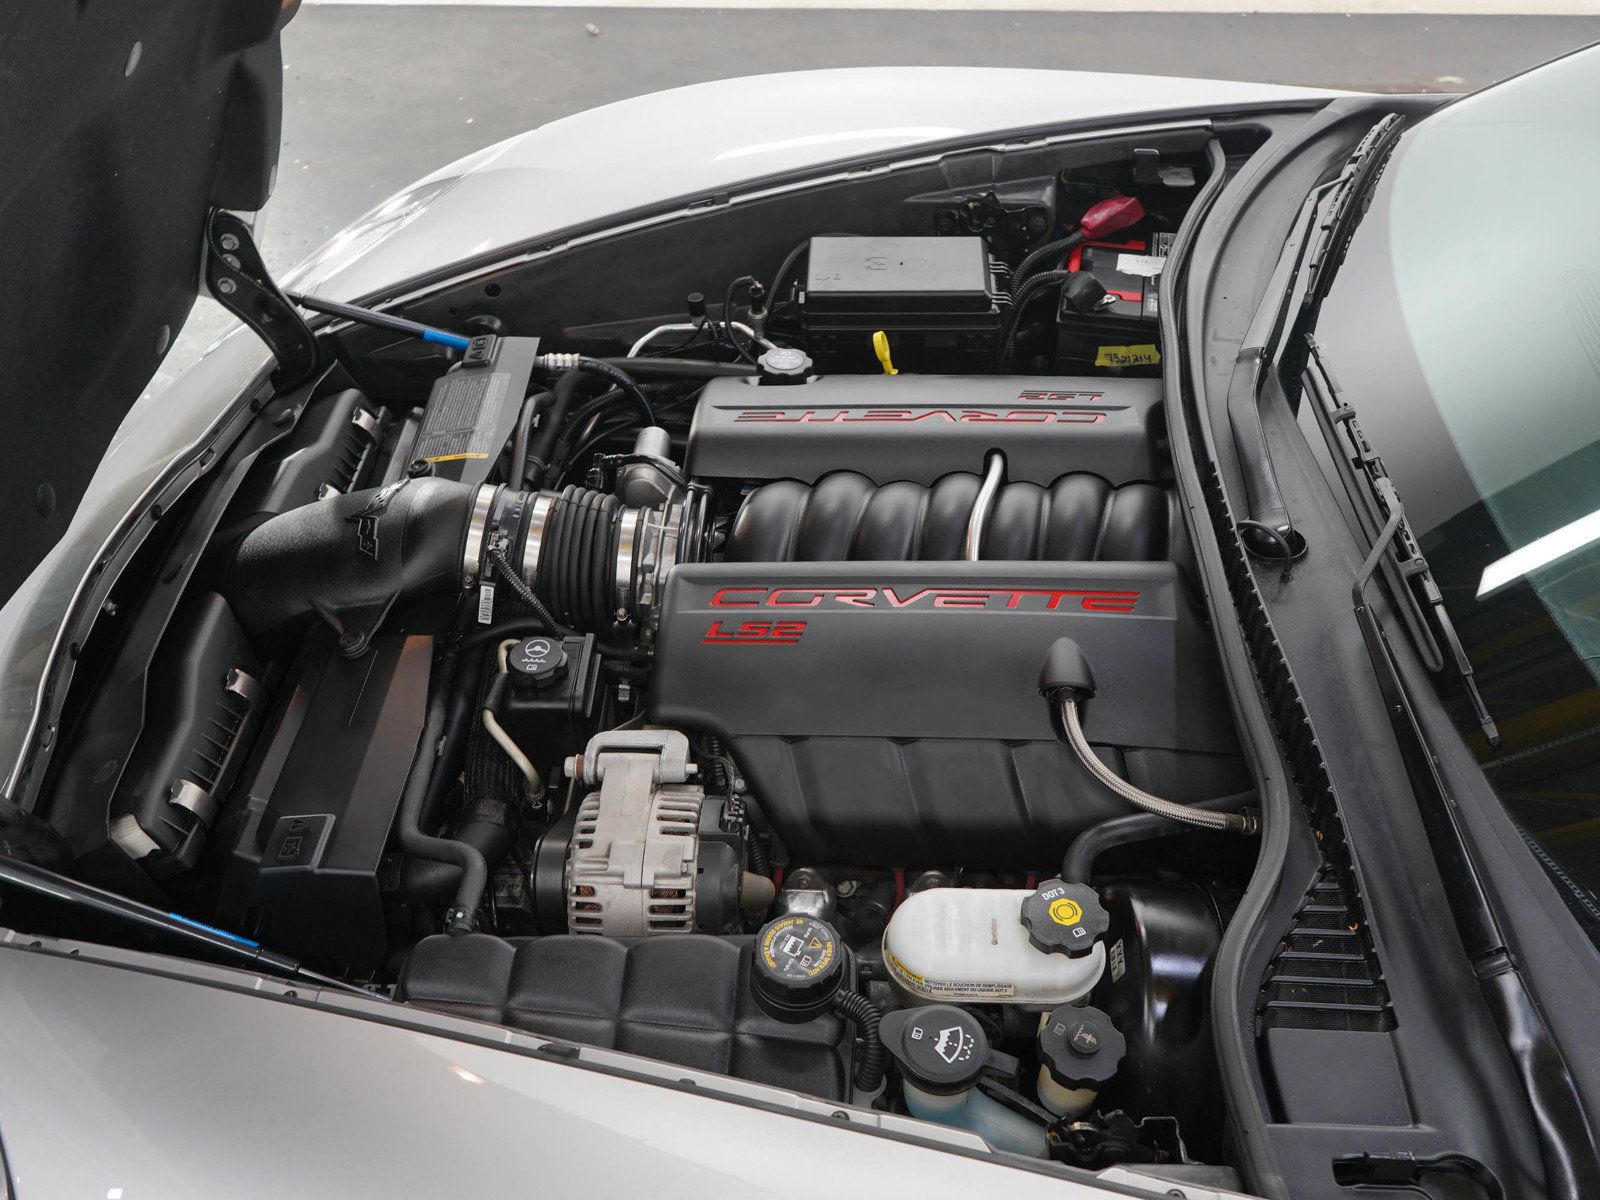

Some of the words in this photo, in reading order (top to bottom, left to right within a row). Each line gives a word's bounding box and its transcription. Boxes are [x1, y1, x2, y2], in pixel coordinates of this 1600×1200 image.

[1018, 390, 1105, 402] LS2
[734, 410, 1108, 424] CORVETTE
[710, 587, 1141, 612] CORVETTE
[703, 620, 808, 643] LS2
[1041, 889, 1059, 901] DOT
[1058, 887, 1066, 895] 3
